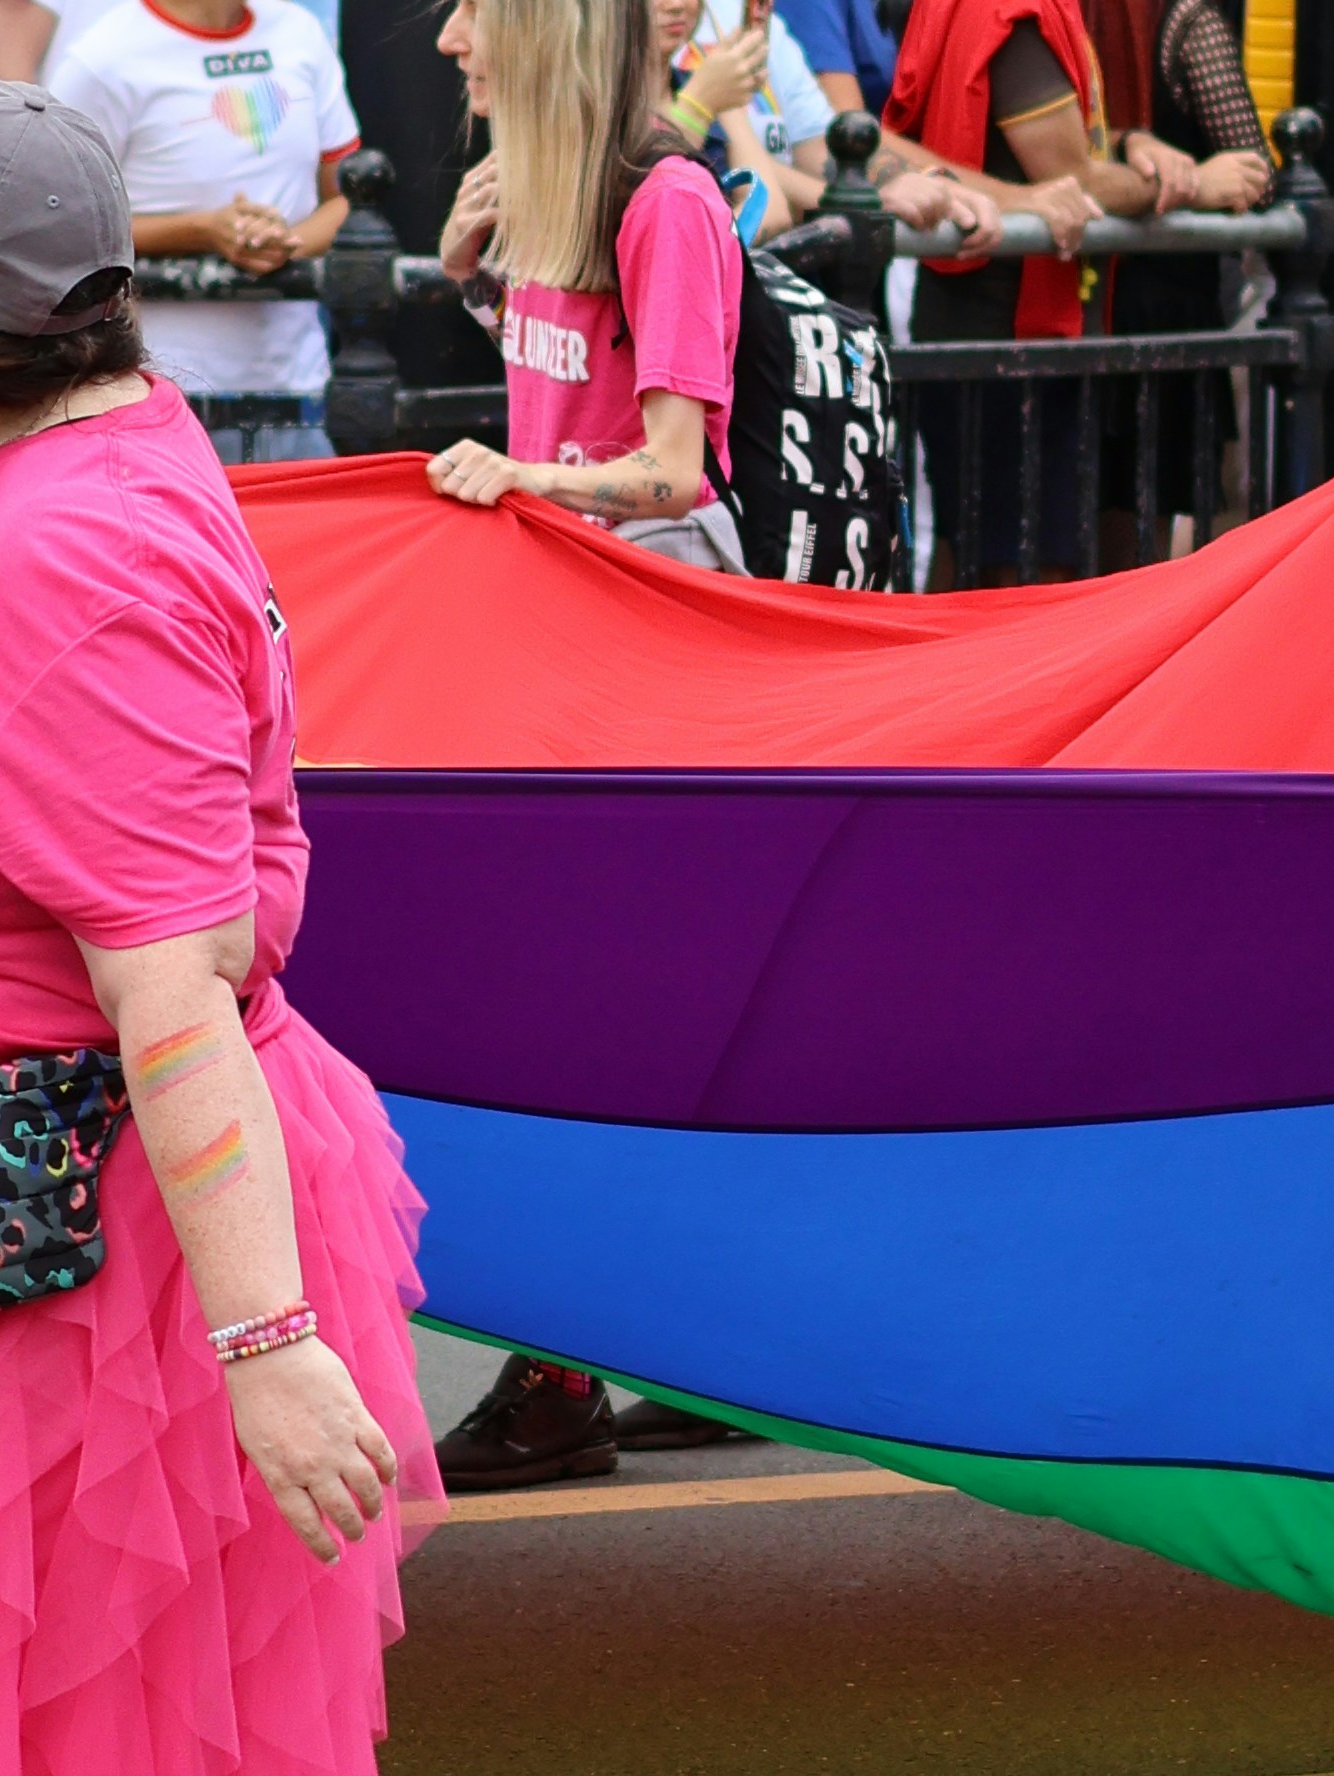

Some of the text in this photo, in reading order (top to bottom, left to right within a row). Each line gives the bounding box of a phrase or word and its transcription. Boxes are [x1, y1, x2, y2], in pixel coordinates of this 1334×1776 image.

[208, 53, 269, 73] DIVA
[798, 524, 817, 582] TOUR EIFFEL
